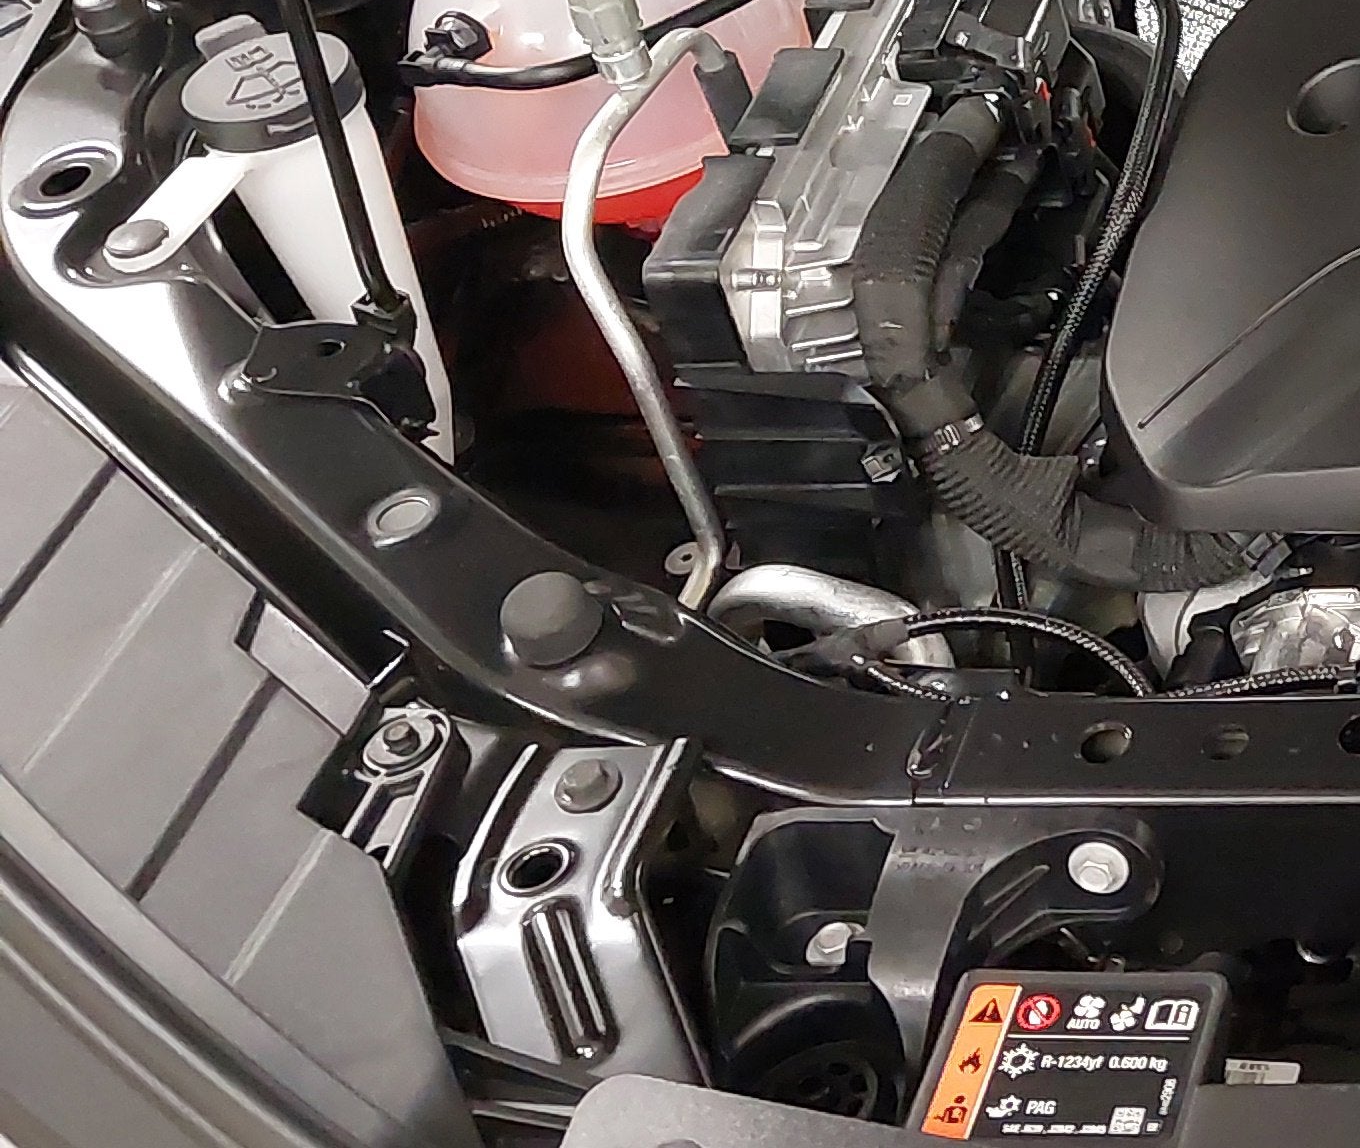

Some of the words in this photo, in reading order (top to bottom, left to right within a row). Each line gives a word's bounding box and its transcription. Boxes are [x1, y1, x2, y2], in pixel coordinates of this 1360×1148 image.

[1066, 1018, 1100, 1030] AUTO
[1041, 1055, 1103, 1072] R-1234yf
[1109, 1055, 1147, 1069] 0.600
[1149, 1055, 1167, 1071] kg
[1025, 1101, 1056, 1115] PAG
